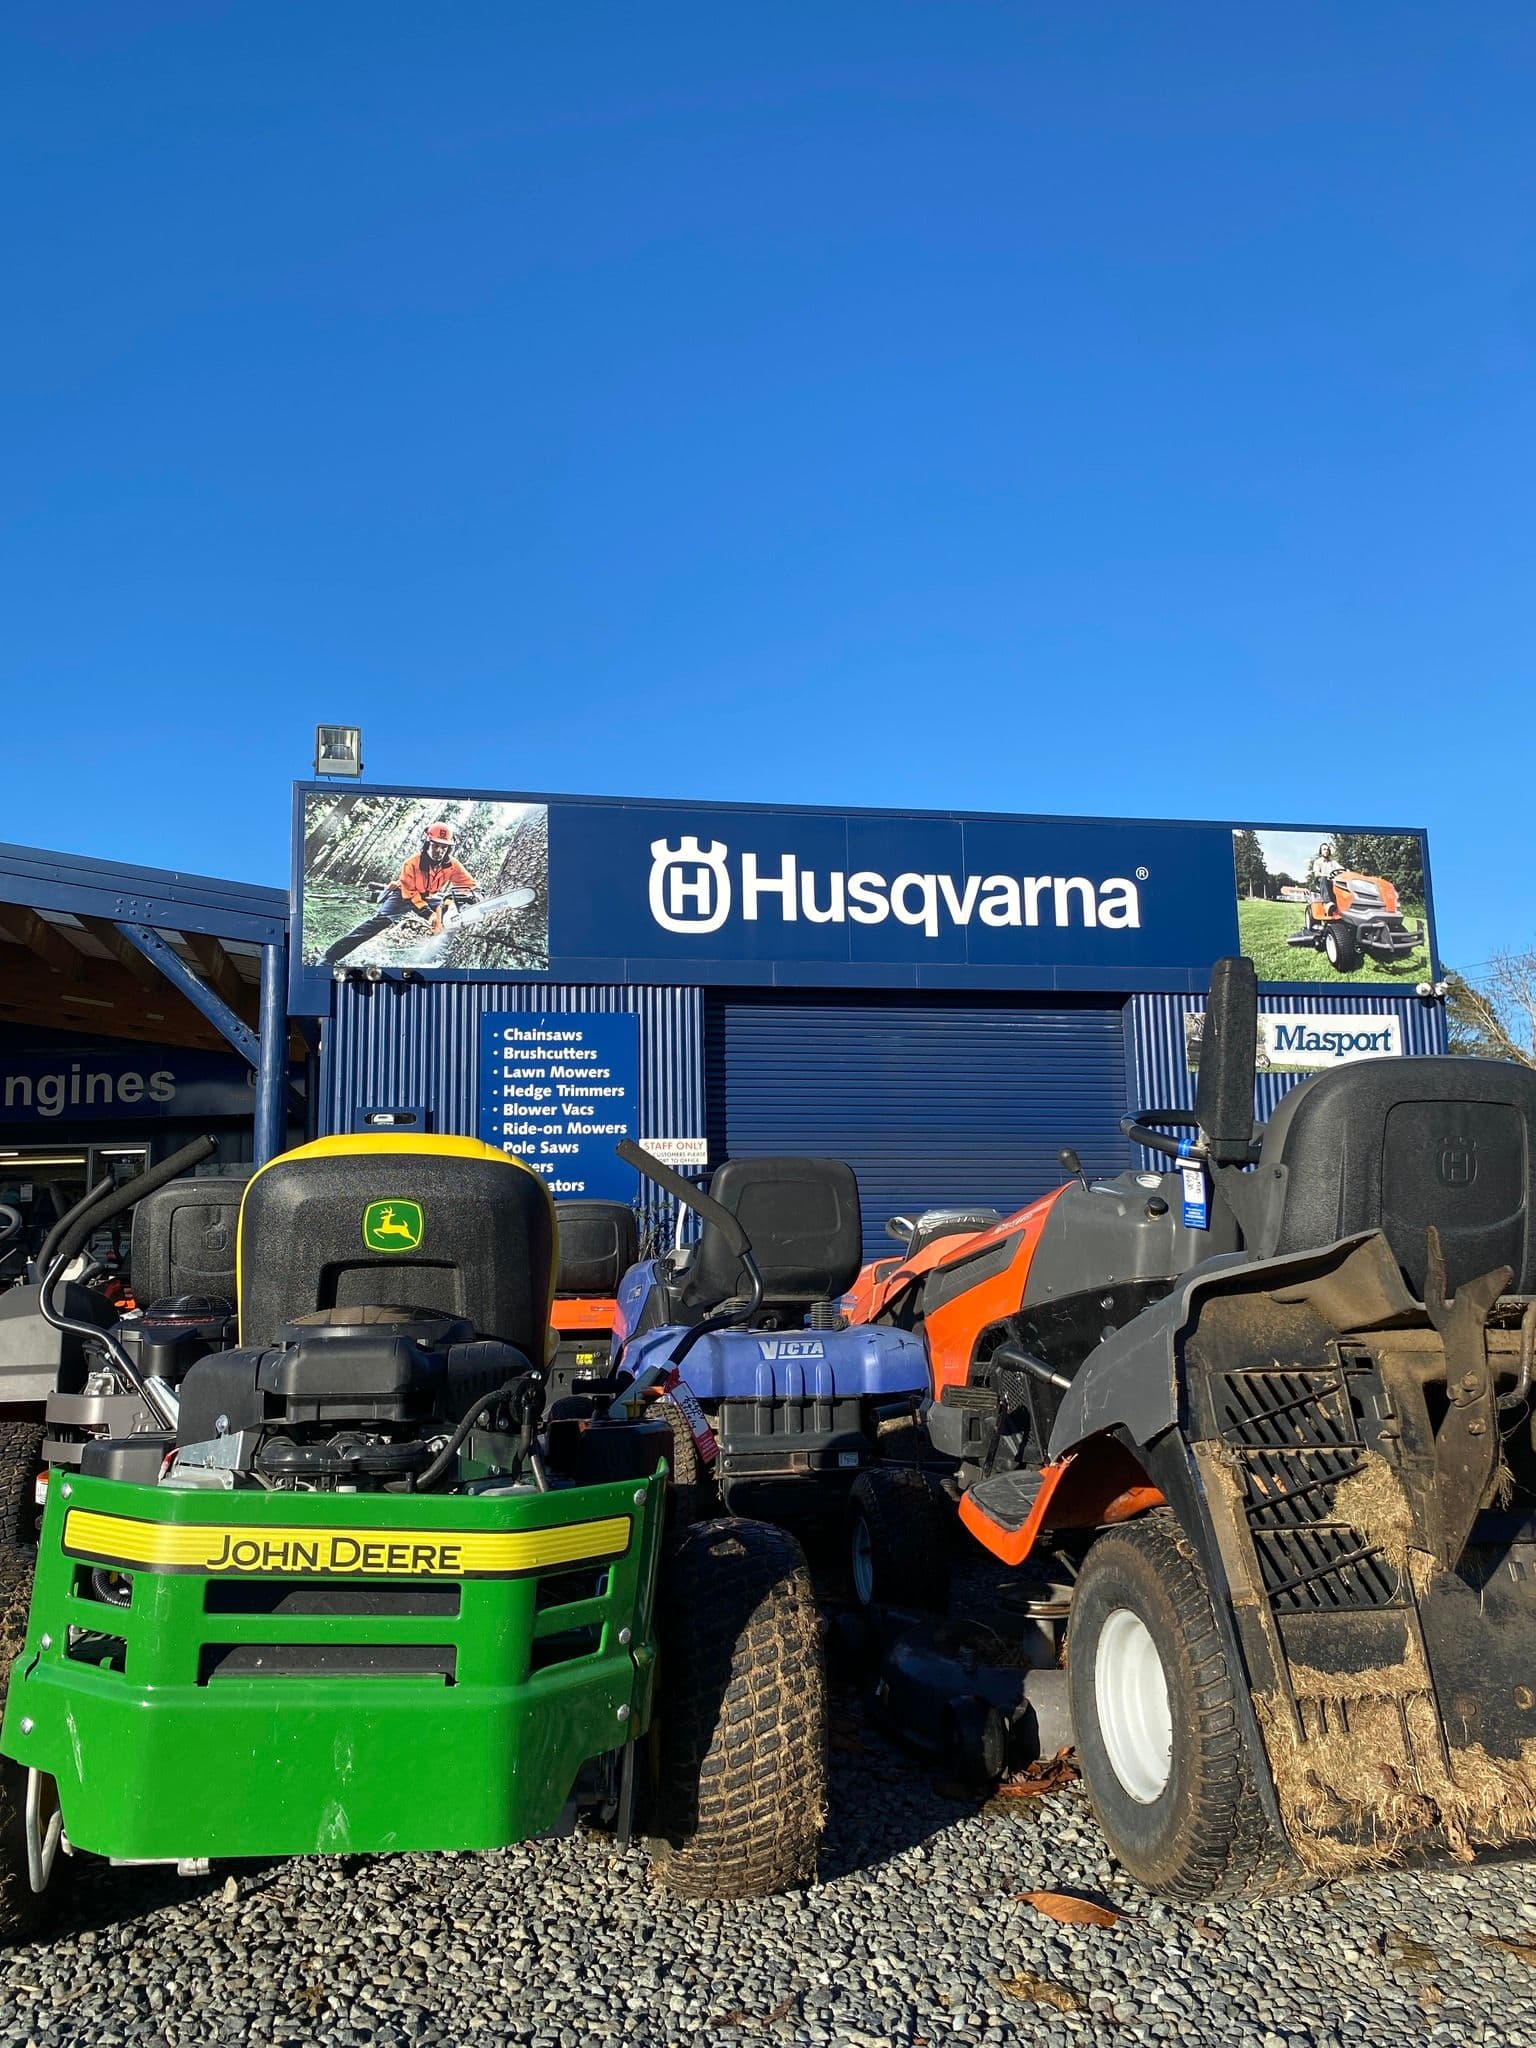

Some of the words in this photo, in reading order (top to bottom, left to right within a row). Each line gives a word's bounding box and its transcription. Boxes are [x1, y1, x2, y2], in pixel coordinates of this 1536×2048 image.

[503, 1028, 584, 1042] Chainsaws
[1274, 1023, 1393, 1057] Masport
[503, 1047, 598, 1061] Brushcutters
[503, 1065, 546, 1079] Lawn
[550, 1065, 611, 1079] Mowers
[4, 1063, 177, 1118] ngines
[503, 1084, 552, 1101] Hedge
[556, 1084, 625, 1098] Trimmers
[503, 1103, 558, 1117] Blower
[561, 1103, 595, 1116] Vacs
[503, 1122, 562, 1136] Ride-on
[567, 1121, 628, 1135] Mowers
[503, 1141, 535, 1155] Pole
[540, 1141, 580, 1155] Saws
[644, 1141, 674, 1151] STAFF
[676, 1141, 705, 1151] ONLY
[528, 1162, 555, 1174] ers
[758, 1340, 825, 1360] VICTA
[206, 1534, 320, 1569] JOHN
[329, 1536, 463, 1571] DEERE
